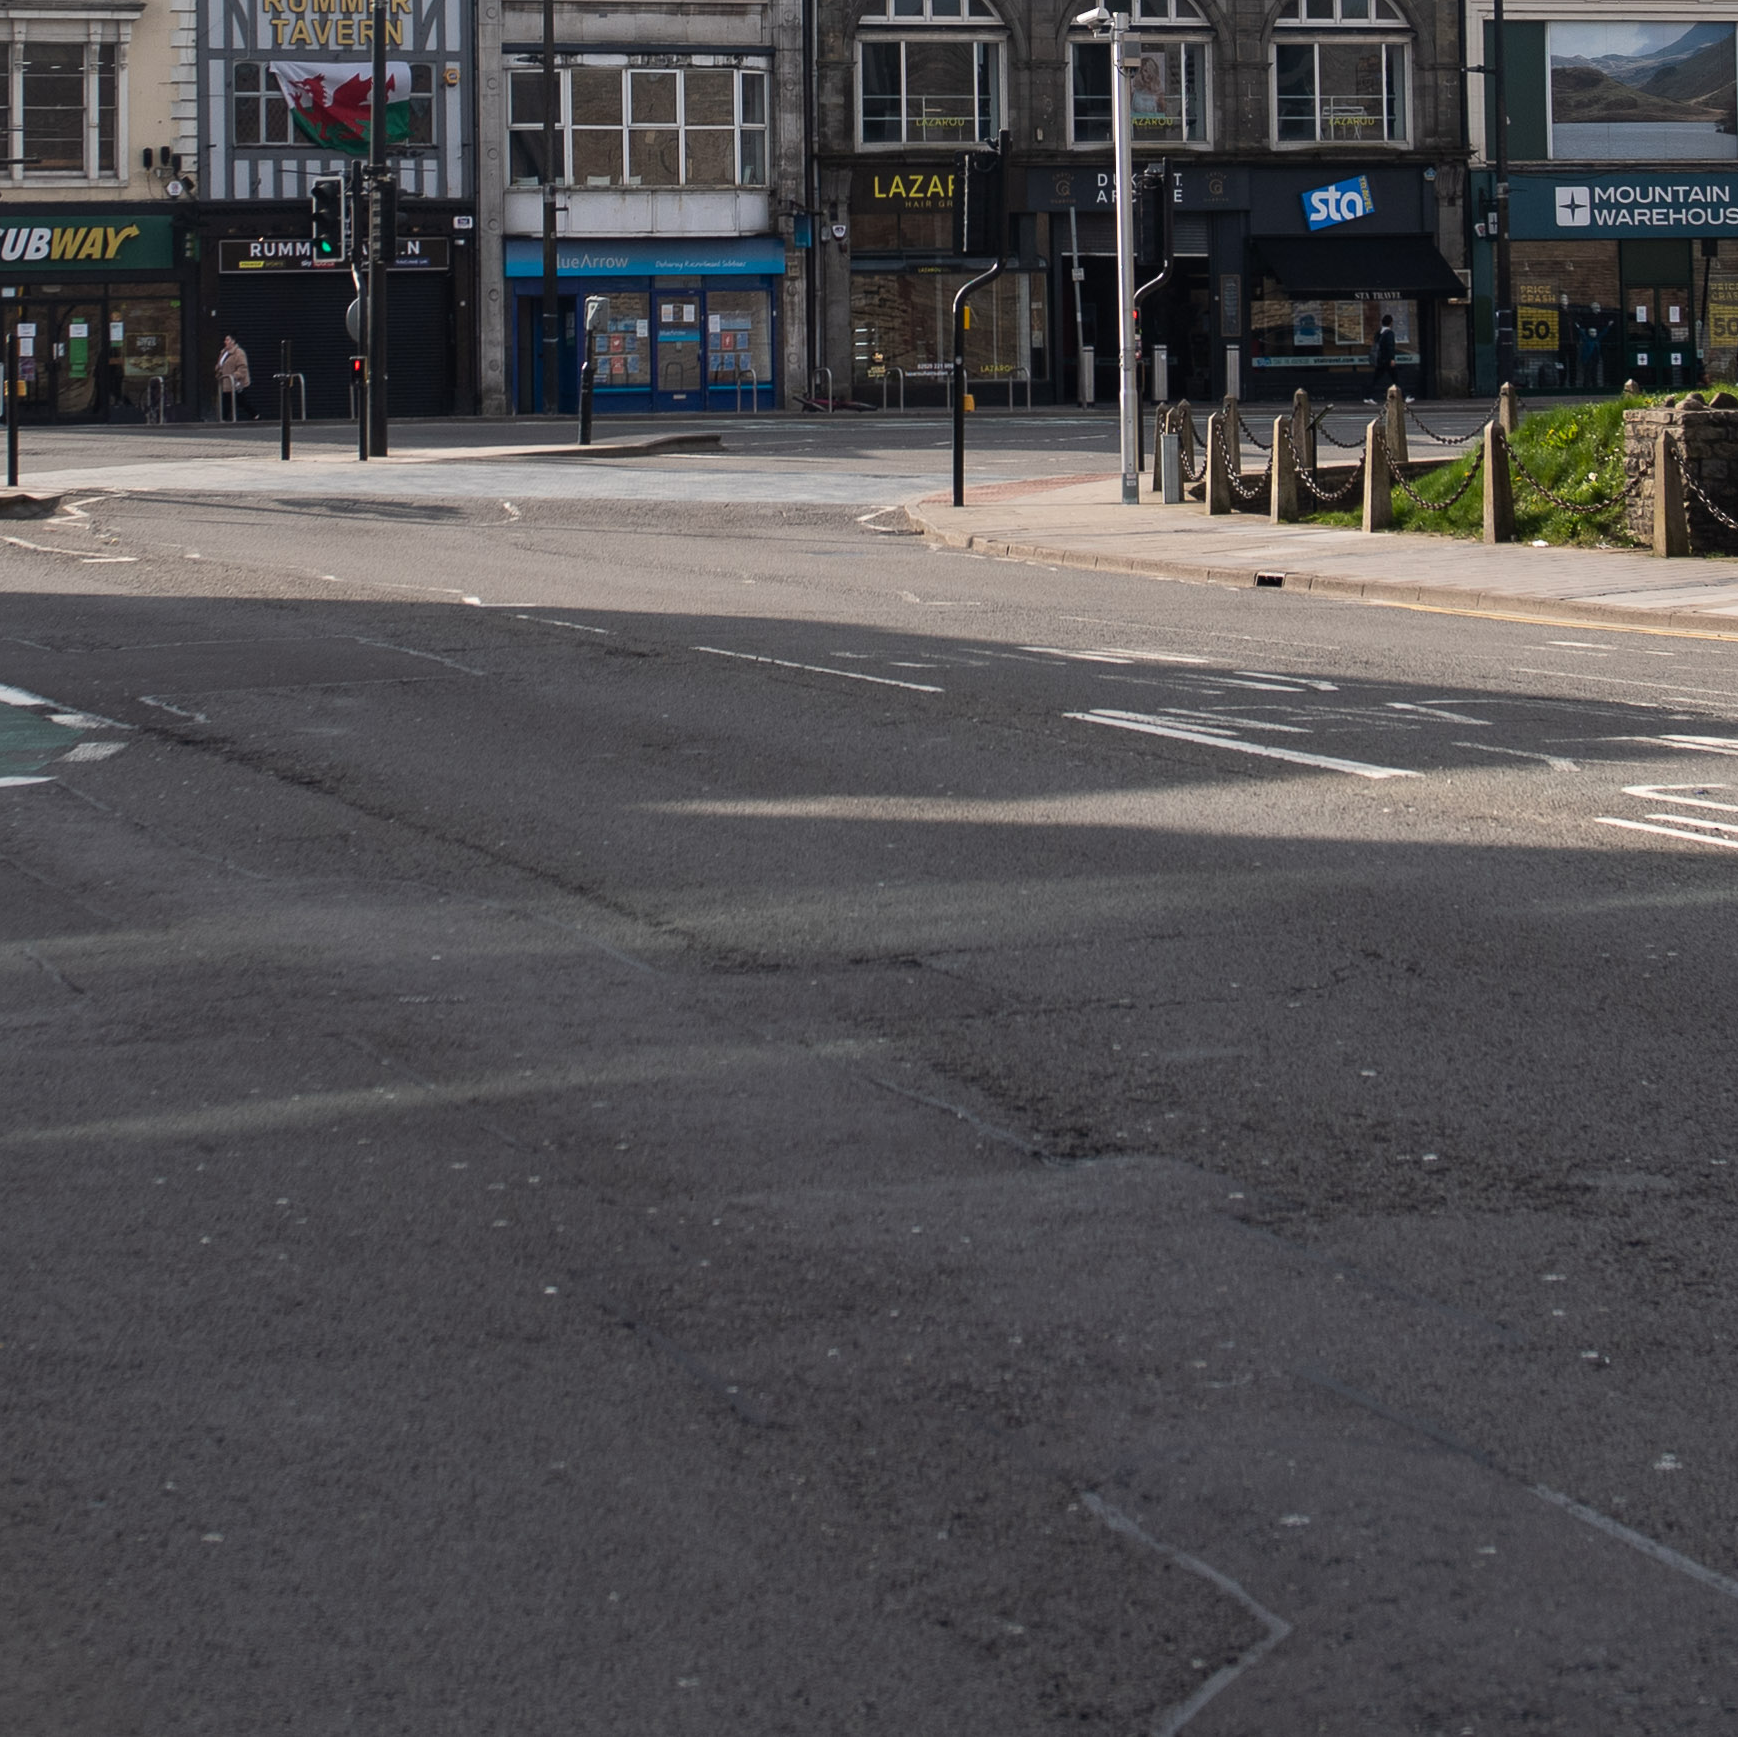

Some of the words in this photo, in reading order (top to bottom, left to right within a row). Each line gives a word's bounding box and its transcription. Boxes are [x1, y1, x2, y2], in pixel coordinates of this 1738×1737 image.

[1131, 117, 1173, 126] AZAROU
[1594, 186, 1729, 203] MOUNTAIN
[1310, 185, 1364, 222] sta
[250, 241, 311, 257] RUMM
[1372, 291, 1401, 300] TRAVEL
